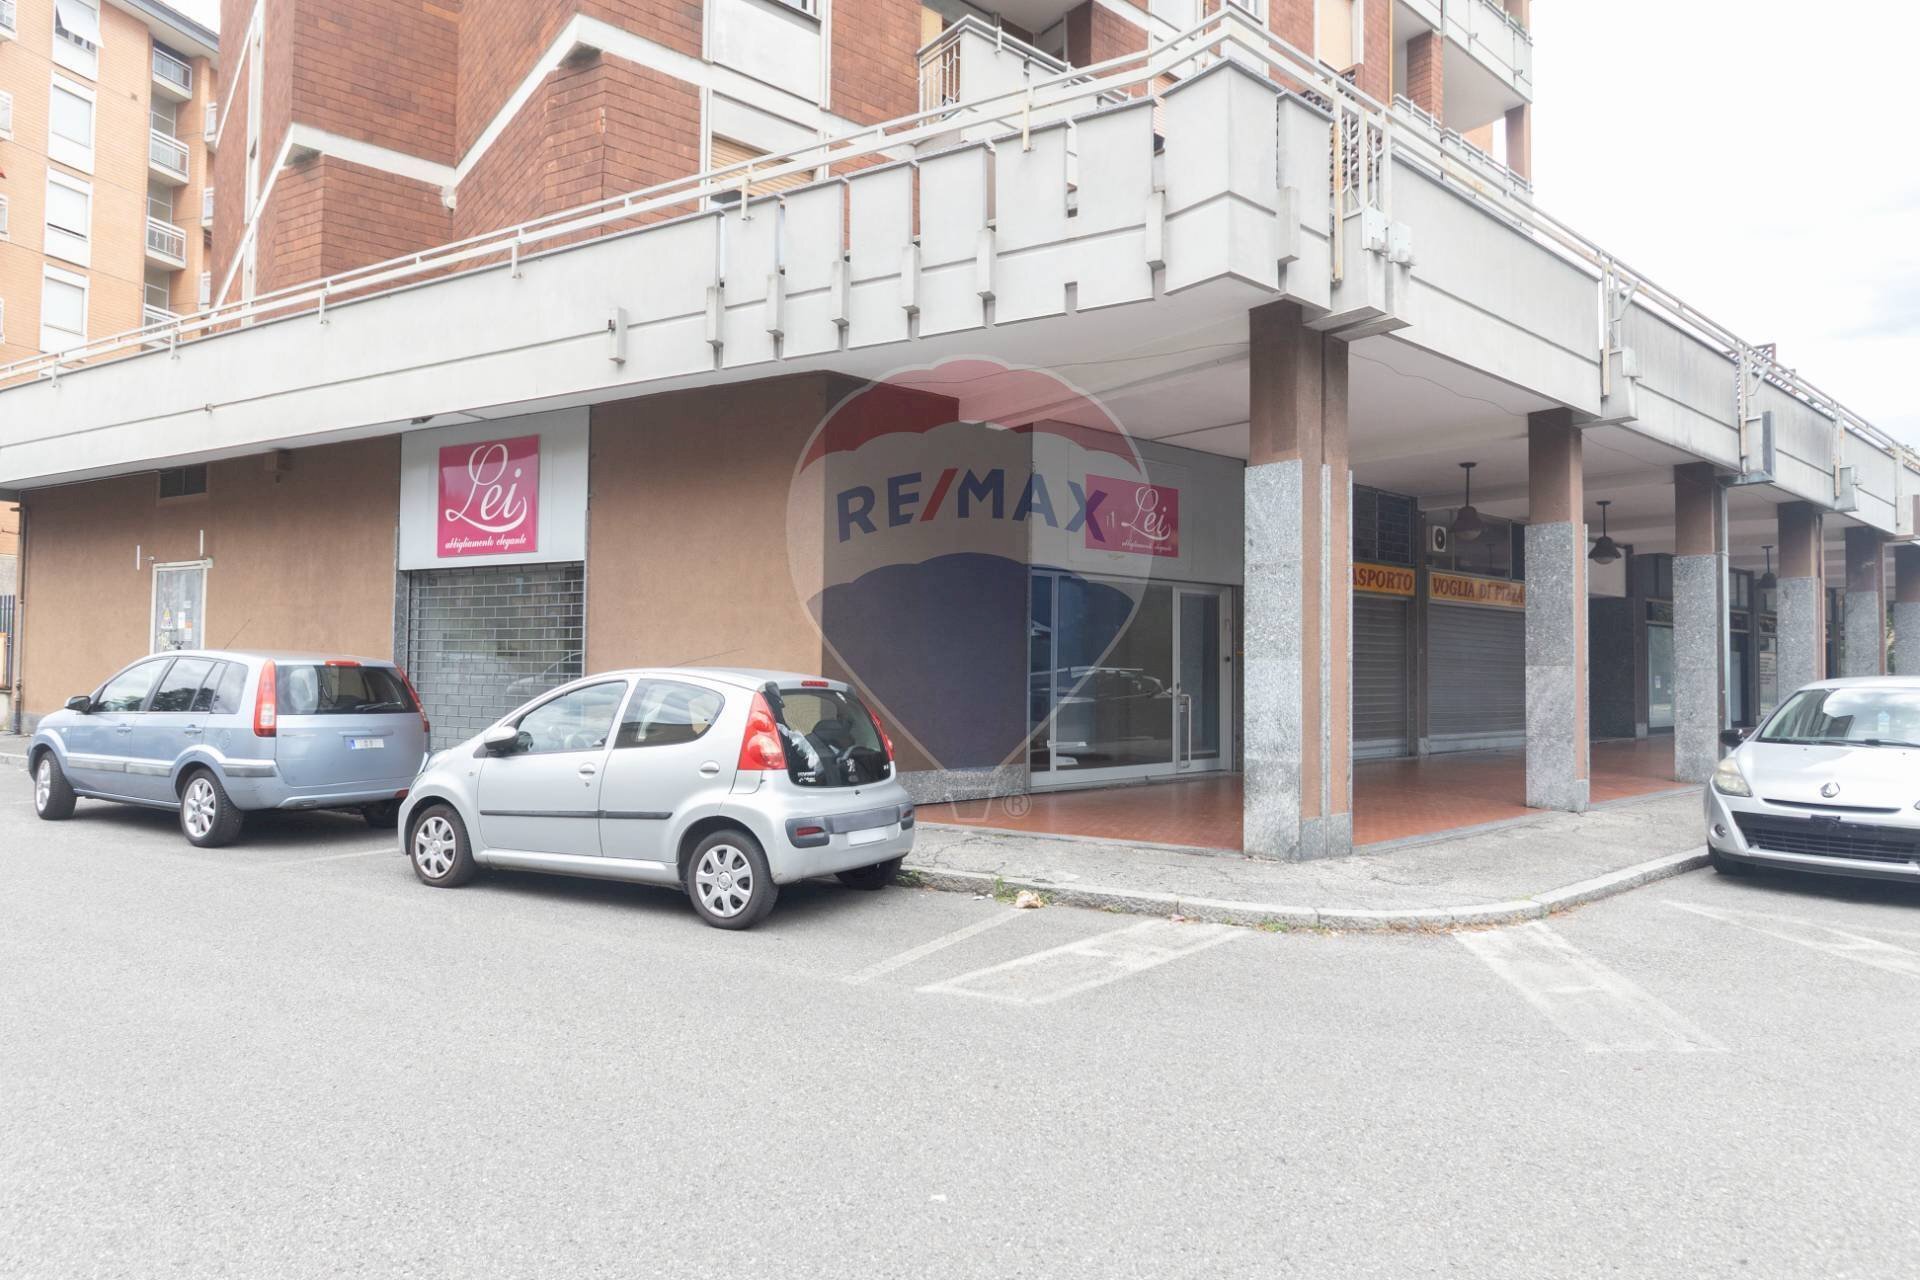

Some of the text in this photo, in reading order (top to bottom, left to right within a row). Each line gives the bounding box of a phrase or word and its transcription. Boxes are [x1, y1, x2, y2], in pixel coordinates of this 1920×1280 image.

[445, 443, 527, 533] Lei
[1121, 486, 1171, 541] Lei
[445, 533, 527, 553] abbigliamento elegante
[1433, 577, 1475, 598] VOGLIA
[1479, 583, 1492, 600] DI
